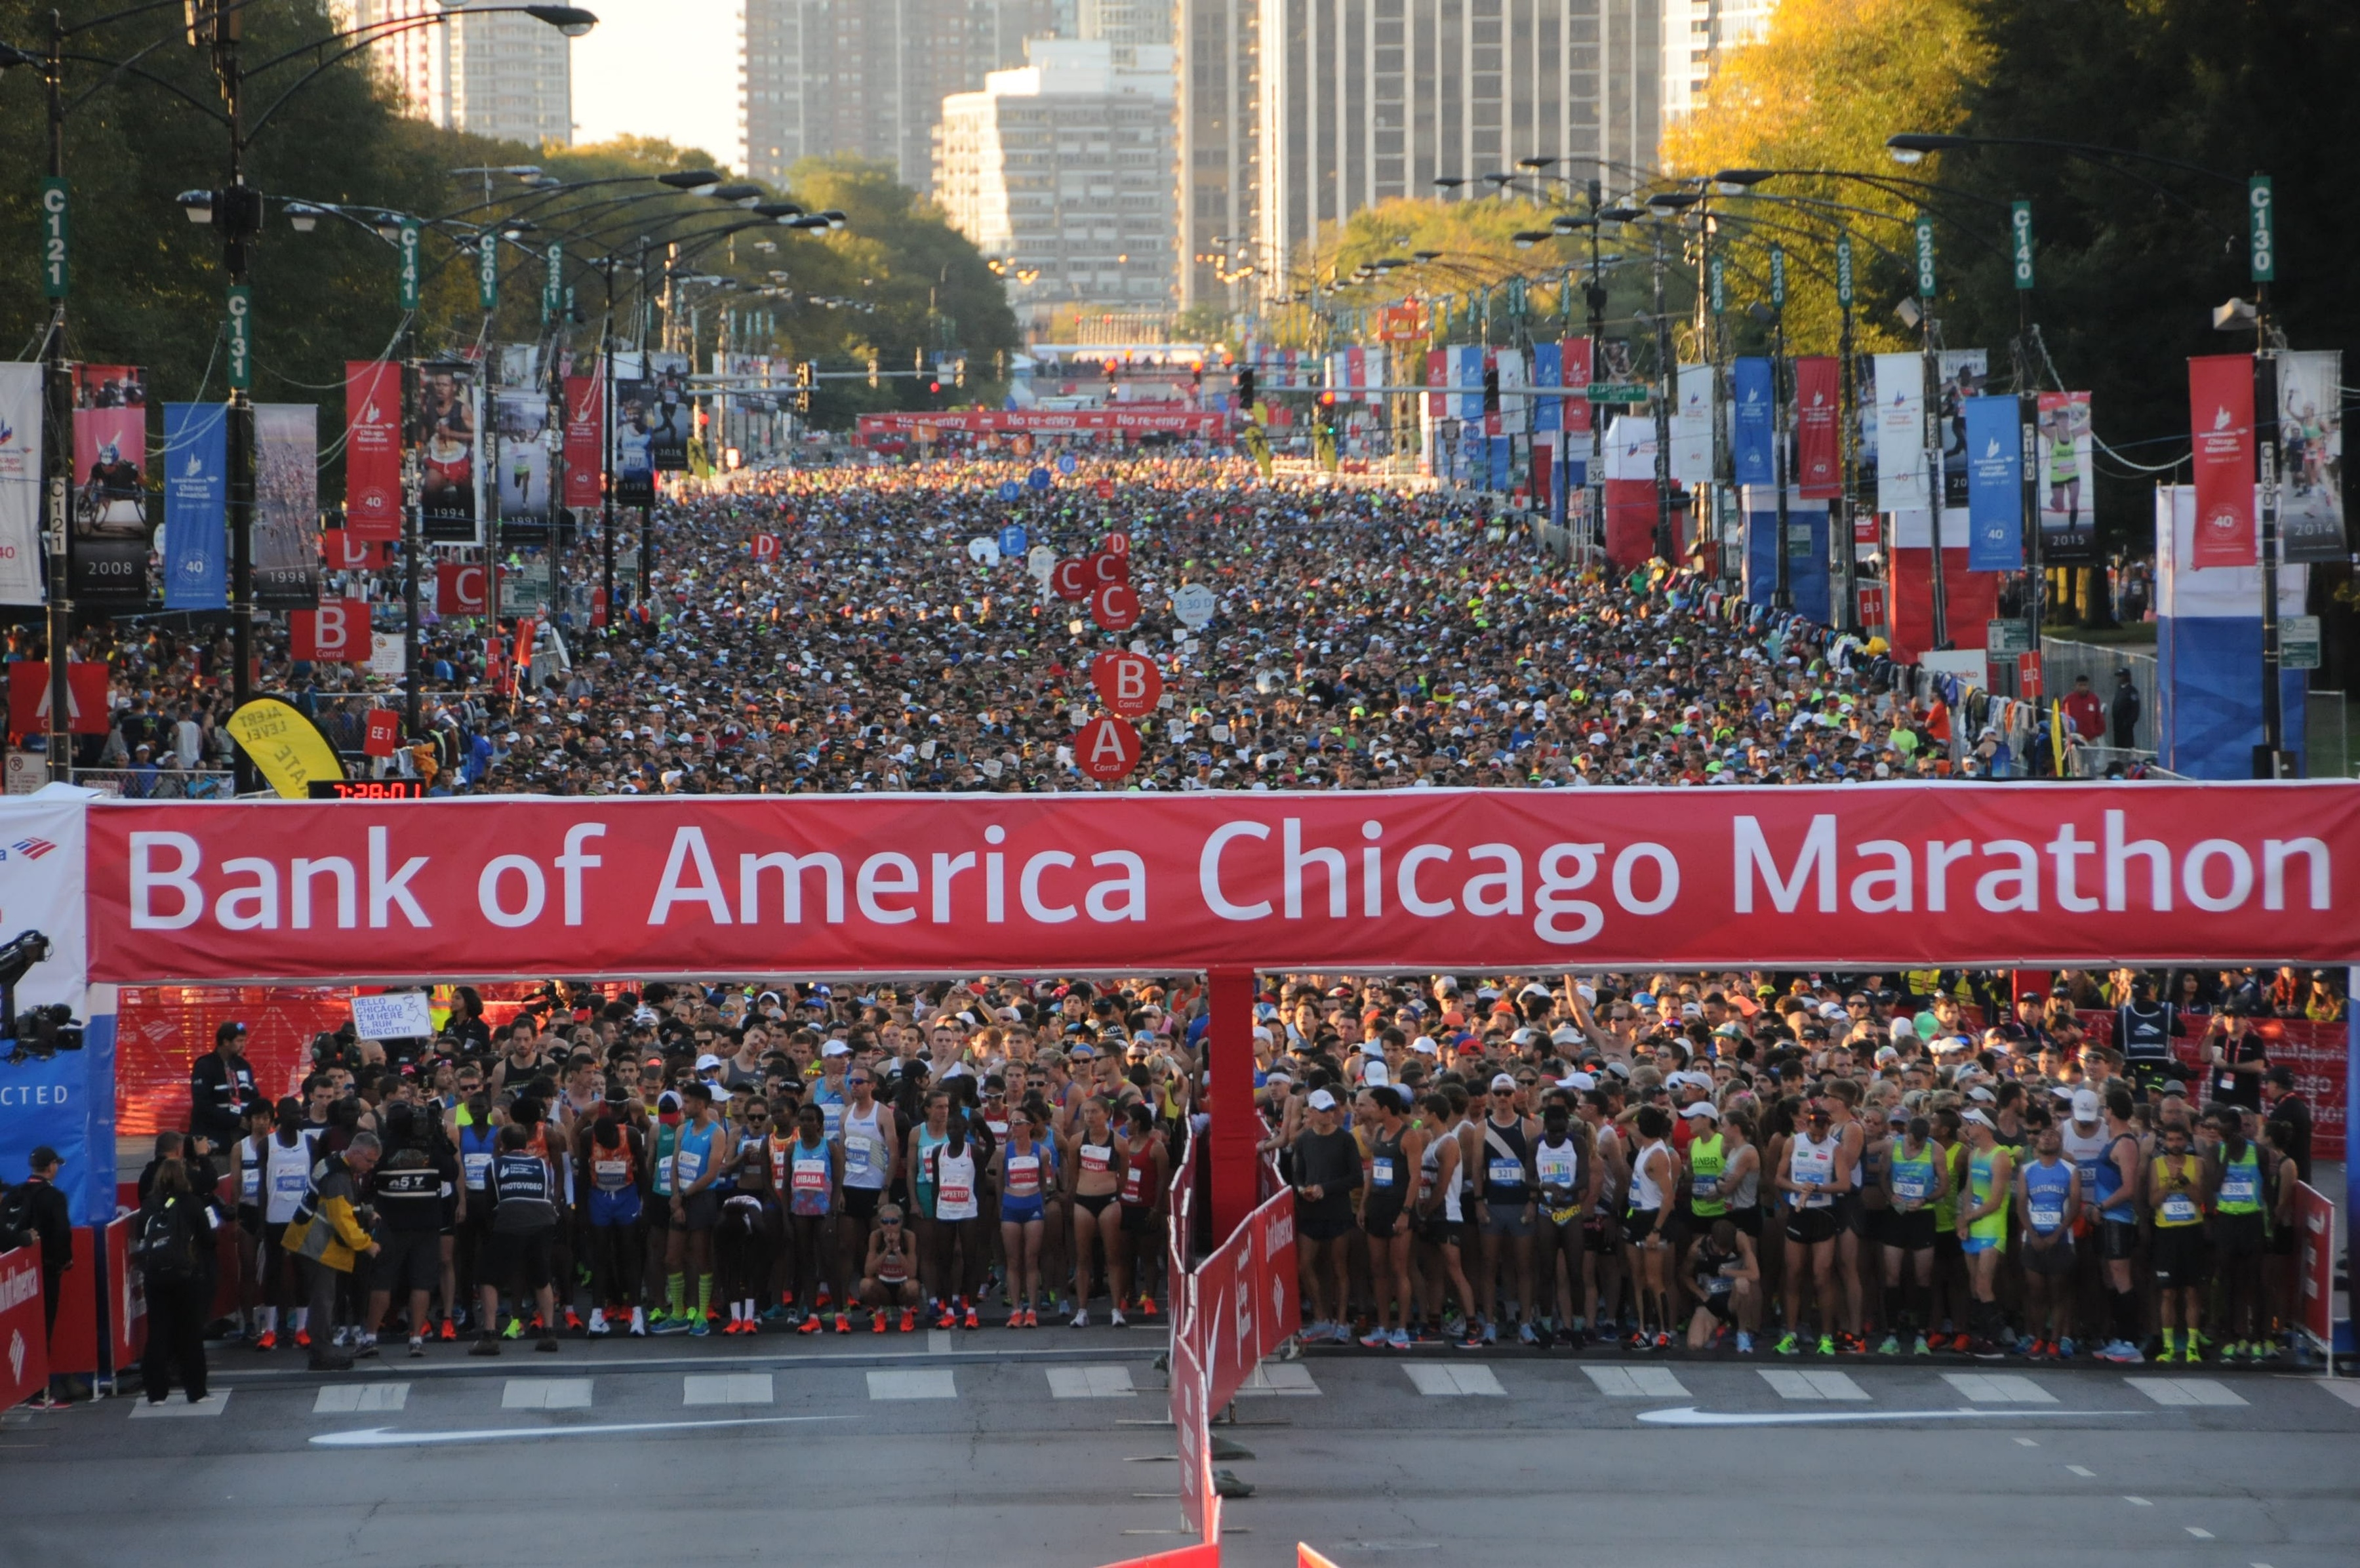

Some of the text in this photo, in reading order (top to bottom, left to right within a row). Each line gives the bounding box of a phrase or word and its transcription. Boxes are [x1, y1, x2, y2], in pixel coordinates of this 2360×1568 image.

[2250, 186, 2271, 271] C130
[44, 190, 65, 285] C121
[2013, 209, 2031, 280] C140
[1916, 224, 1933, 289] C200
[401, 228, 416, 300] C141
[480, 235, 495, 300] C201
[548, 245, 561, 304] C221
[1771, 250, 1783, 302] C240
[1837, 243, 1851, 301] C220
[228, 294, 247, 377] C131
[897, 416, 967, 428] No re-entry
[1007, 414, 1077, 428] No re-entry
[1117, 414, 1188, 428] No re-entry
[1589, 470, 1605, 481] 30
[1895, 473, 1908, 482] 40
[2262, 445, 2273, 506] C130
[365, 496, 382, 508] 40
[51, 481, 64, 552] C121
[433, 508, 466, 519] 1994
[2214, 515, 2233, 528] 40
[1988, 529, 2004, 540] 40
[2295, 523, 2334, 536] 2014
[757, 534, 774, 555] D
[1112, 533, 1125, 553] D
[2052, 534, 2085, 546] 2015
[88, 561, 134, 575] 2008
[186, 560, 203, 573] 40
[1096, 554, 1116, 580] C
[270, 572, 306, 583] 1998
[1062, 562, 1081, 590] C
[456, 567, 483, 605] C
[458, 604, 482, 613] Corral
[1102, 586, 1126, 617] C
[1875, 601, 1881, 613] 3
[315, 605, 347, 648] B
[316, 649, 344, 658] Corral
[1117, 660, 1146, 699] B
[2033, 668, 2039, 680] 2
[35, 677, 81, 717] A
[1117, 700, 1144, 708] Corral
[371, 725, 392, 741] EE 1
[1090, 720, 1126, 763] A
[1094, 763, 1121, 773] Corral
[130, 809, 2330, 944] Bank of America Chicago Marathon
[354, 997, 386, 1007] HELLO
[356, 1004, 403, 1015] CHICAGO
[358, 1011, 404, 1022] I'M HERE
[360, 1026, 411, 1037] THIS CITY!
[1497, 1169, 1512, 1178] 321
[400, 1176, 410, 1188] 5
[500, 1181, 543, 1192] PHOTO/VIDEO
[2171, 1203, 2188, 1213] 354
[2037, 1213, 2054, 1222] 350
